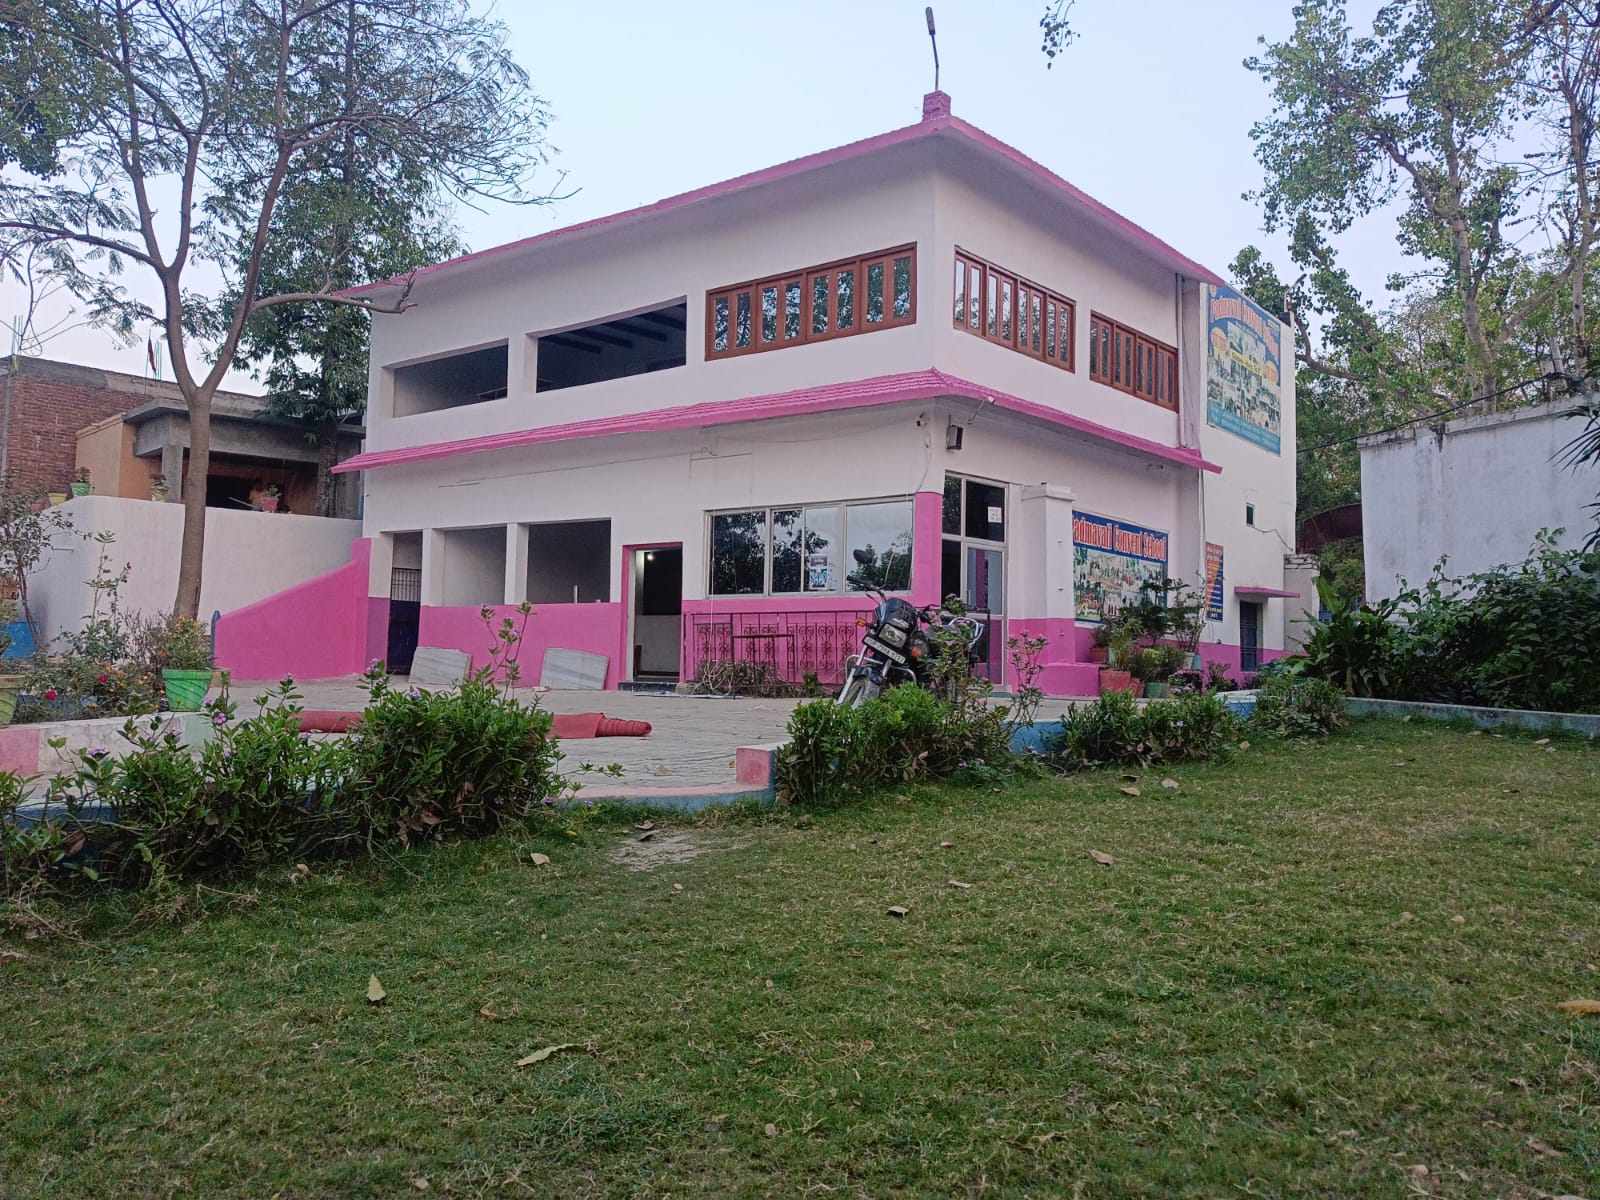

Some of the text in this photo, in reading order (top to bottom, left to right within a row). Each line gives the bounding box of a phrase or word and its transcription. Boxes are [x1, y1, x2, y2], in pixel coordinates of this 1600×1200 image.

[1072, 515, 1167, 561] admavati Convent School
